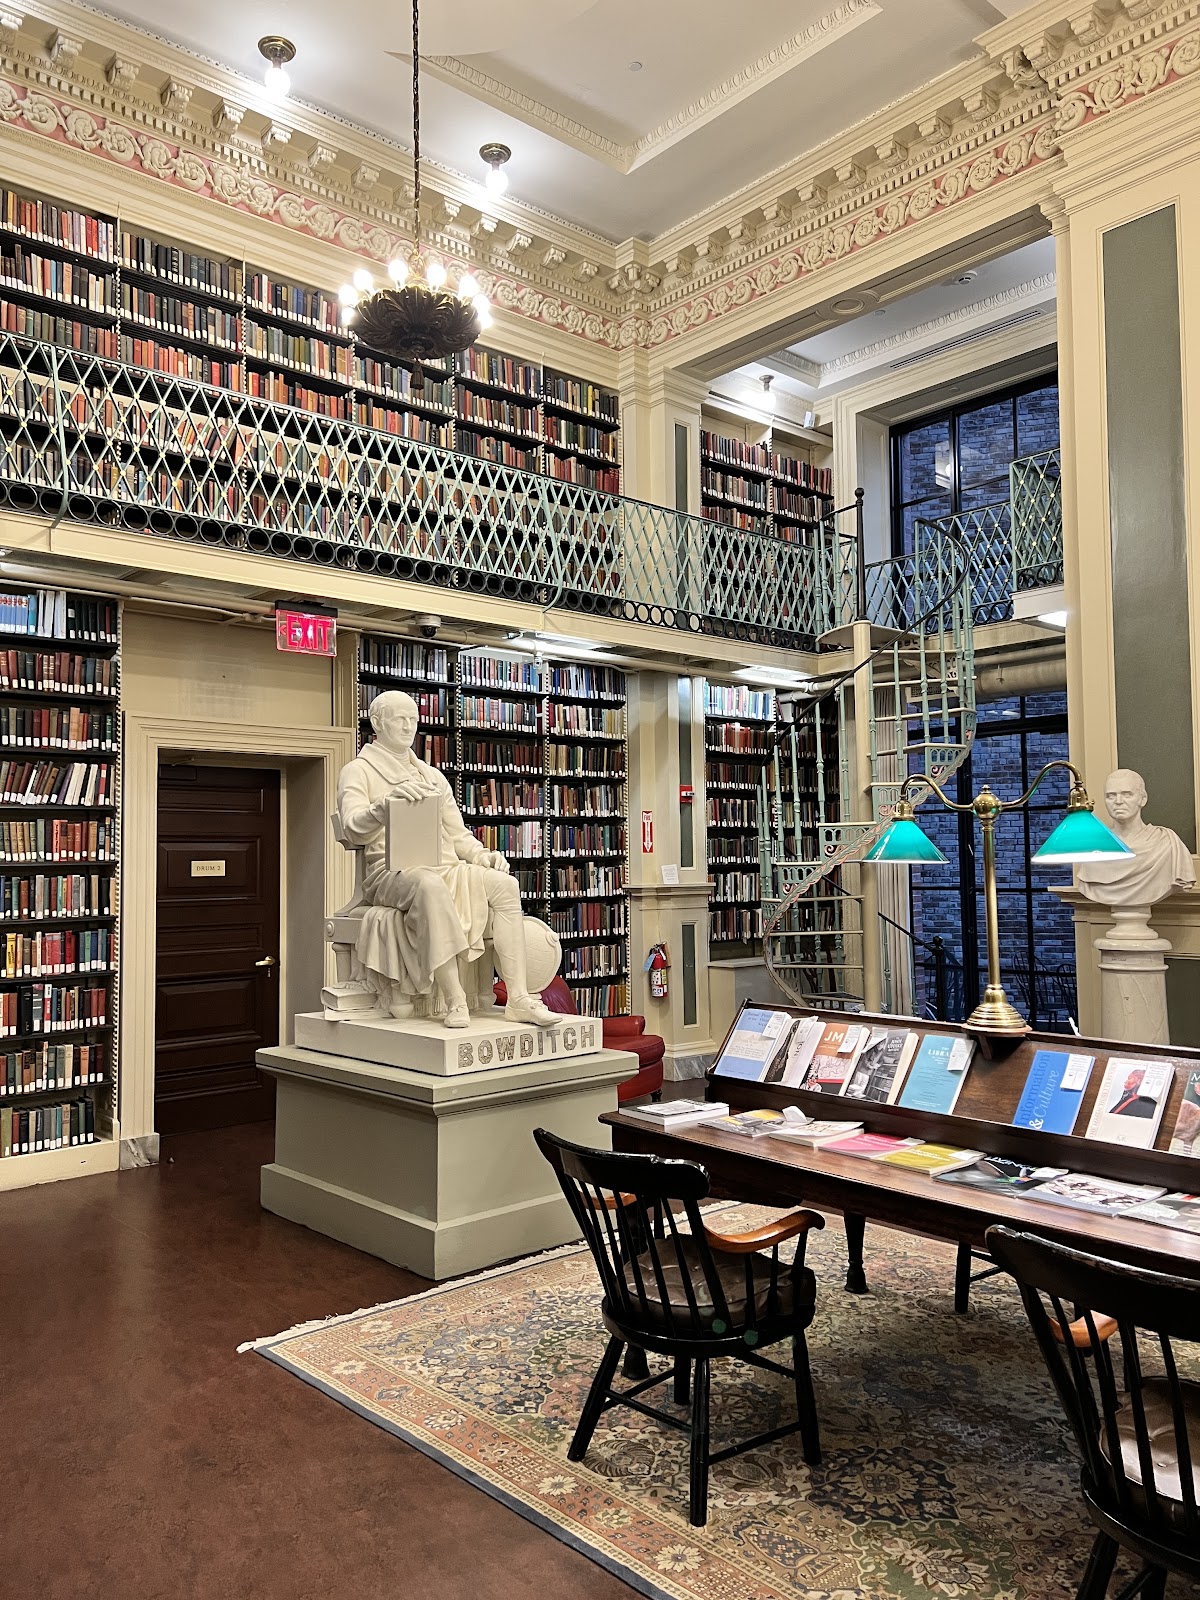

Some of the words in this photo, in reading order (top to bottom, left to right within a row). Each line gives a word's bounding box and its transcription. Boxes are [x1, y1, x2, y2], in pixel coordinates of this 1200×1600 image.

[286, 614, 332, 652] EXIT
[458, 1024, 595, 1069] BOWDITCH
[928, 1049, 950, 1057] LIBRA
[1014, 1054, 1051, 1127] Information
[1033, 1070, 1060, 1118] Culture
[1028, 1117, 1045, 1130] &
